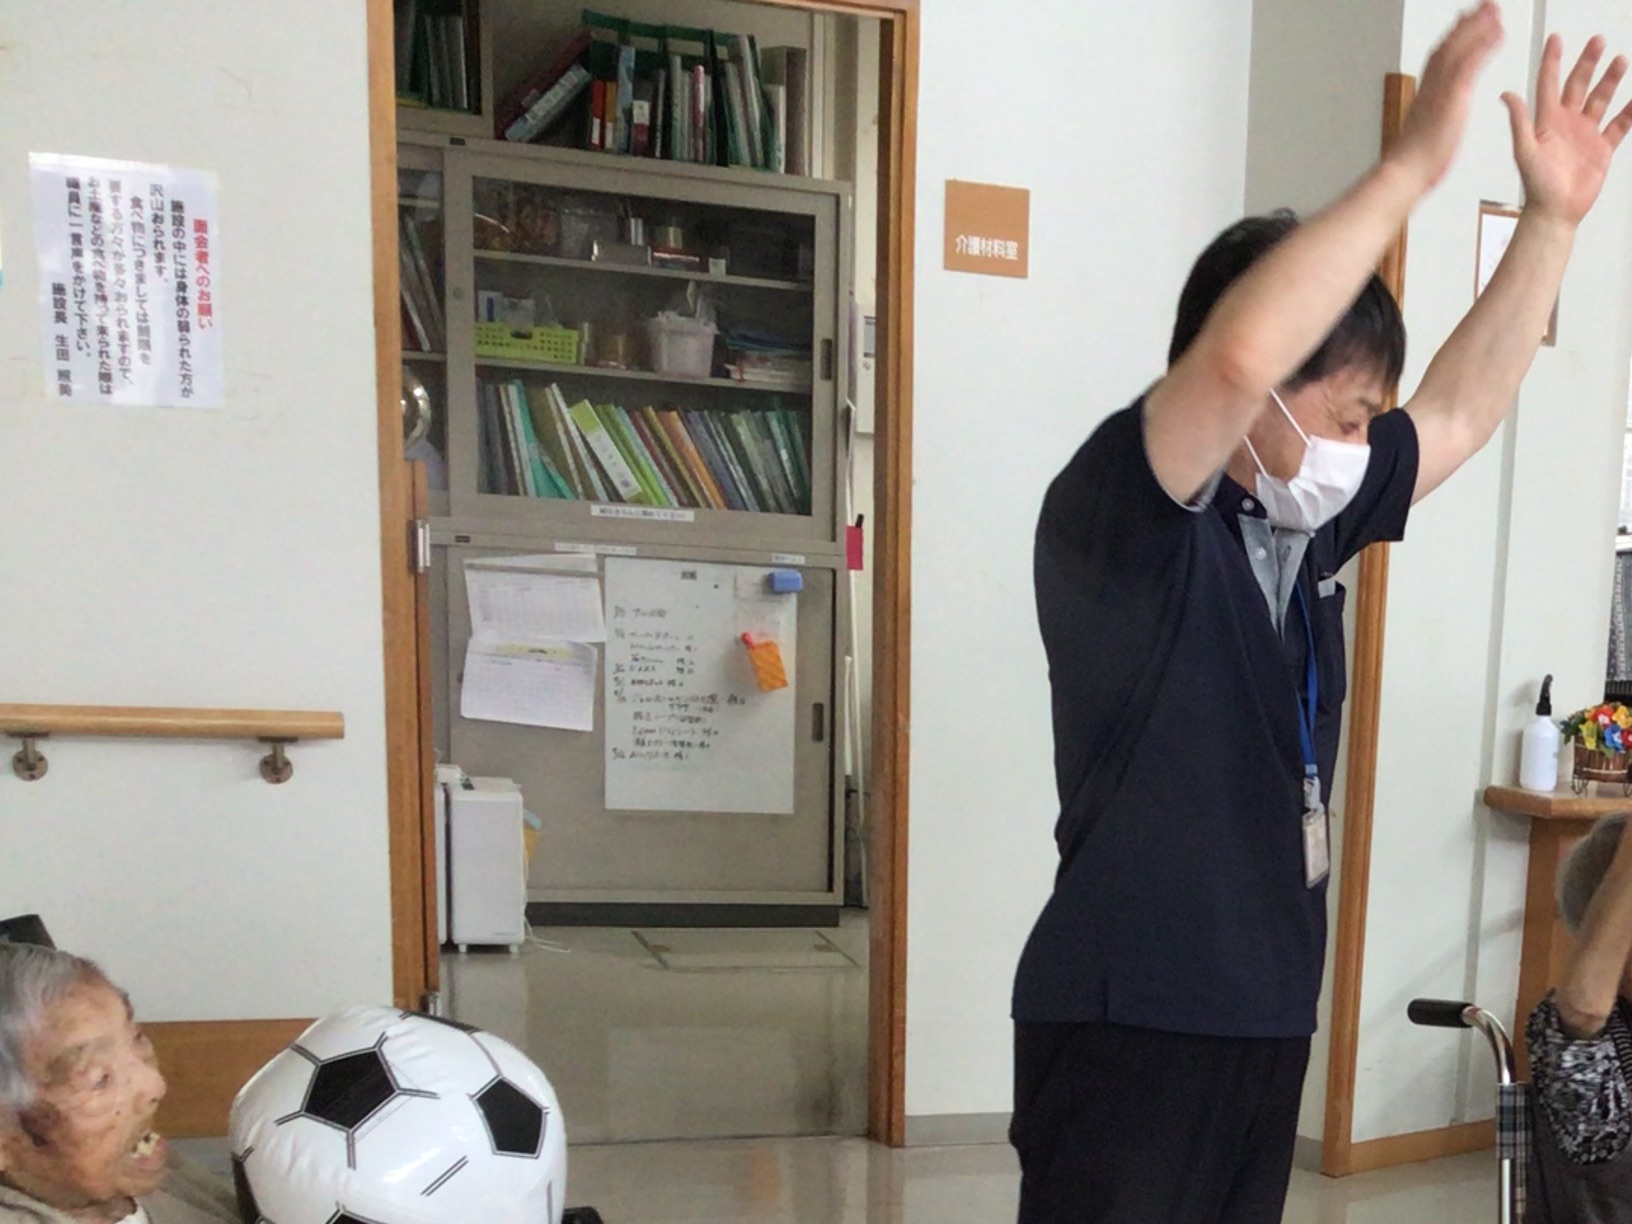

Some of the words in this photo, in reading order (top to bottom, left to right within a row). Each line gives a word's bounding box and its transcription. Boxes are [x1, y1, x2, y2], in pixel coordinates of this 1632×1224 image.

[193, 218, 213, 329] 面会者へのお願い
[955, 234, 1018, 260] 介護材料室
